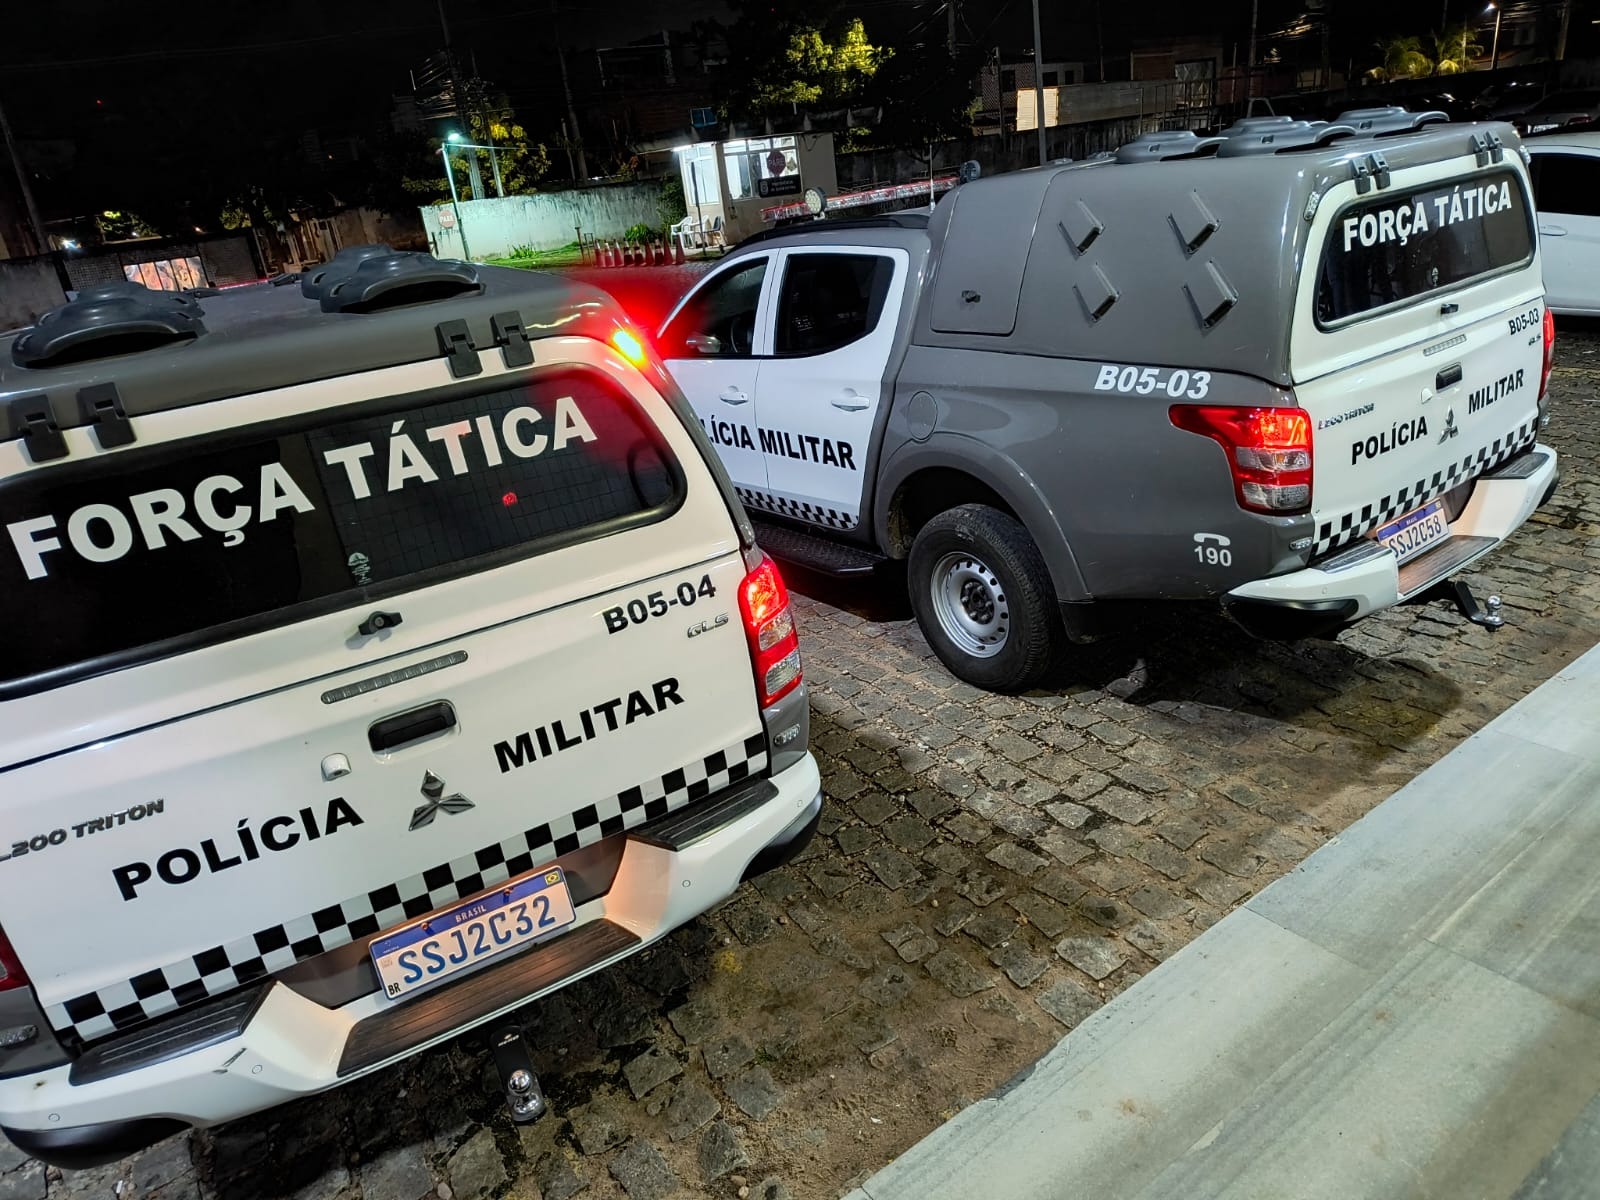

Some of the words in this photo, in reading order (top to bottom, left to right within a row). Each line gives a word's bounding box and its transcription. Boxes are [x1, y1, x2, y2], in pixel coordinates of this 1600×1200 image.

[1344, 202, 1429, 252] FORÇA
[1434, 181, 1512, 228] TÁTICA
[1508, 308, 1540, 336] B05-03
[1094, 365, 1211, 399] B05-03
[1468, 369, 1524, 415] MILITAR
[700, 414, 756, 451] ÍCIA
[757, 427, 857, 471] MILITAR
[1351, 416, 1428, 466] POLÍCIA
[6, 462, 316, 581] FORÇA
[323, 396, 598, 500] TÁTICA
[1194, 545, 1232, 567] 190
[1388, 514, 1442, 558] SSJ2C58
[602, 574, 716, 635] B05-04
[687, 612, 729, 639] GLS
[493, 677, 685, 774] MILITAR
[72, 798, 164, 838] TRITON
[112, 796, 364, 901] POLÍCIA
[455, 904, 487, 924] BRASIL
[398, 895, 556, 984] SSJ2C32
[388, 982, 401, 995] BR
